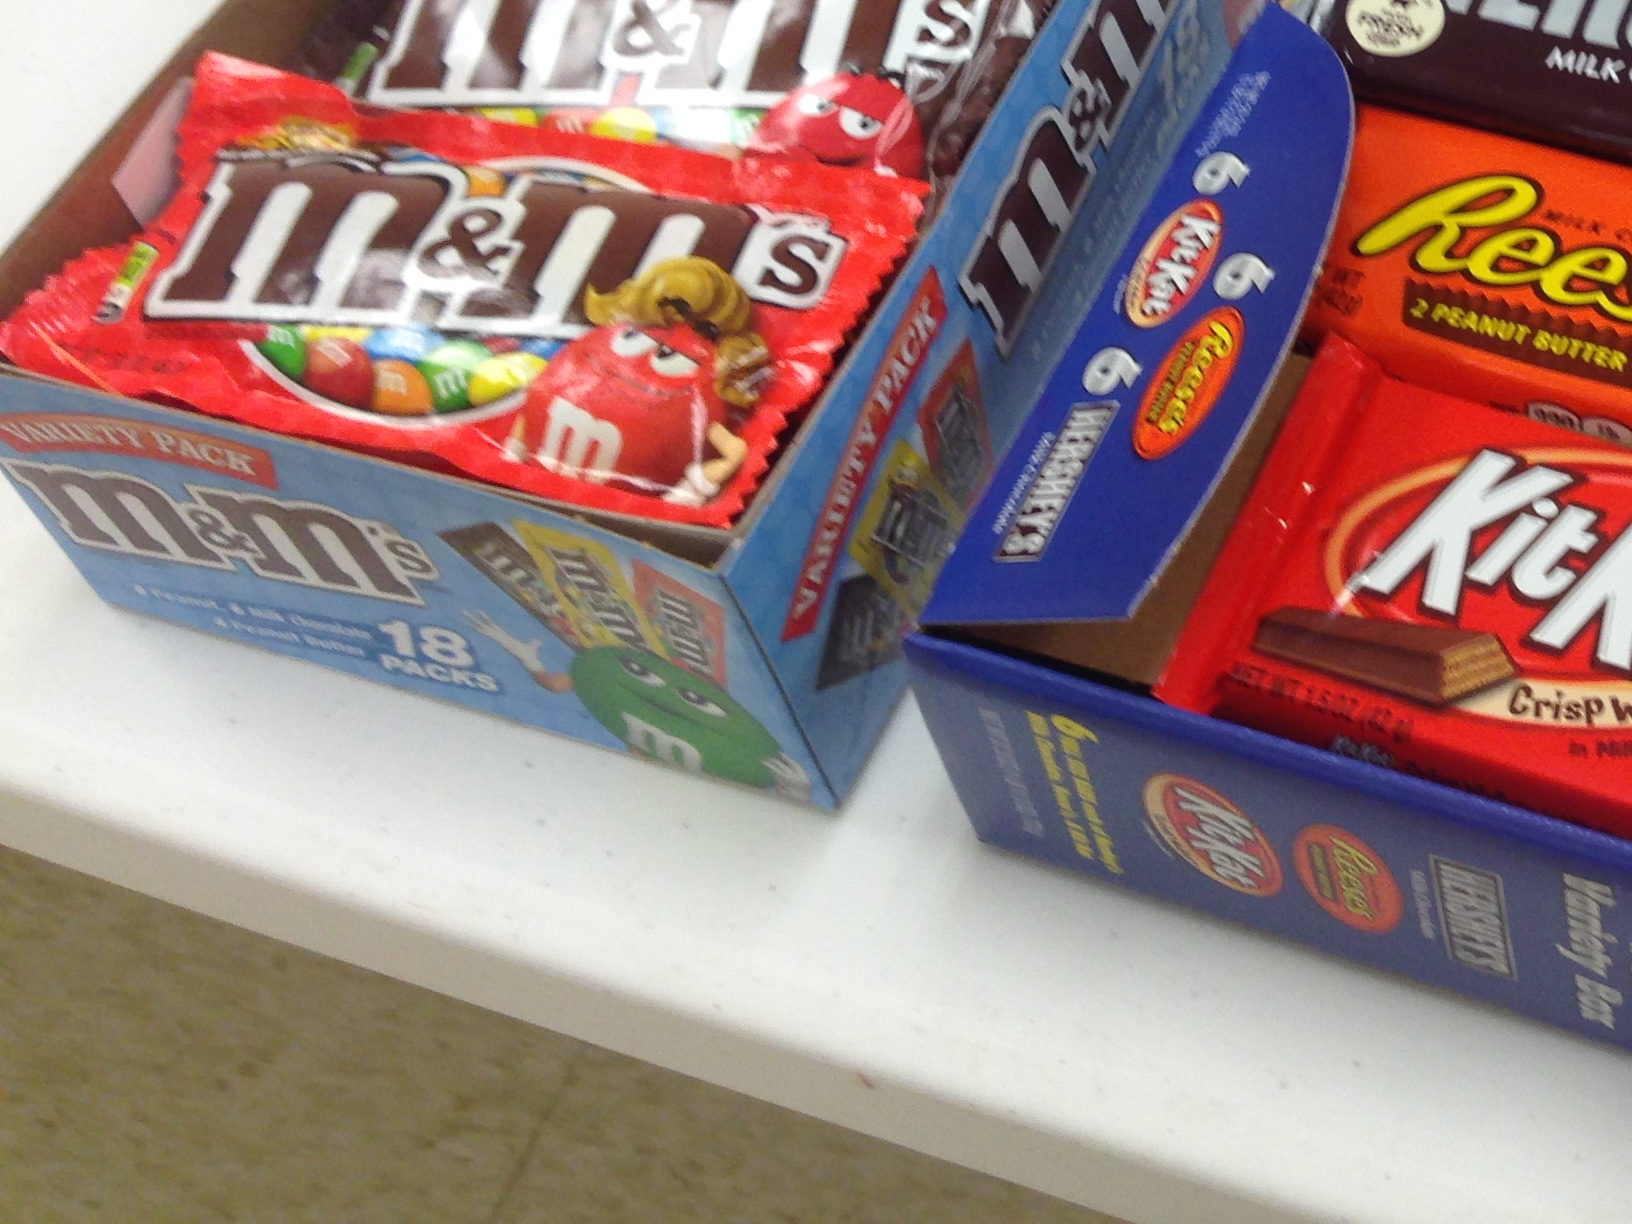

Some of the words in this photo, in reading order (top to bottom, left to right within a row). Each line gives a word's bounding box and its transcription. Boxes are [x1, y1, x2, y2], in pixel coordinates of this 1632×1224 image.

[1545, 44, 1622, 85] MILK
[1192, 150, 1251, 196] 6
[1543, 207, 1603, 235] MILK
[1212, 251, 1276, 301] 6
[1409, 296, 1428, 320] 2
[1431, 302, 1532, 346] PEANUT
[1534, 328, 1627, 374] BUTTER
[1081, 345, 1144, 396] 6
[2, 421, 142, 452] VARIETY
[149, 428, 256, 477] PACK
[793, 419, 878, 619] VARIETY
[871, 295, 938, 414] PACK
[377, 619, 476, 669] 18
[379, 652, 499, 694] PACKS
[1507, 682, 1605, 726] Crisp
[1438, 861, 1512, 977] HERSHEY'S
[1554, 872, 1619, 979] Variety
[1574, 973, 1624, 1030] Box
